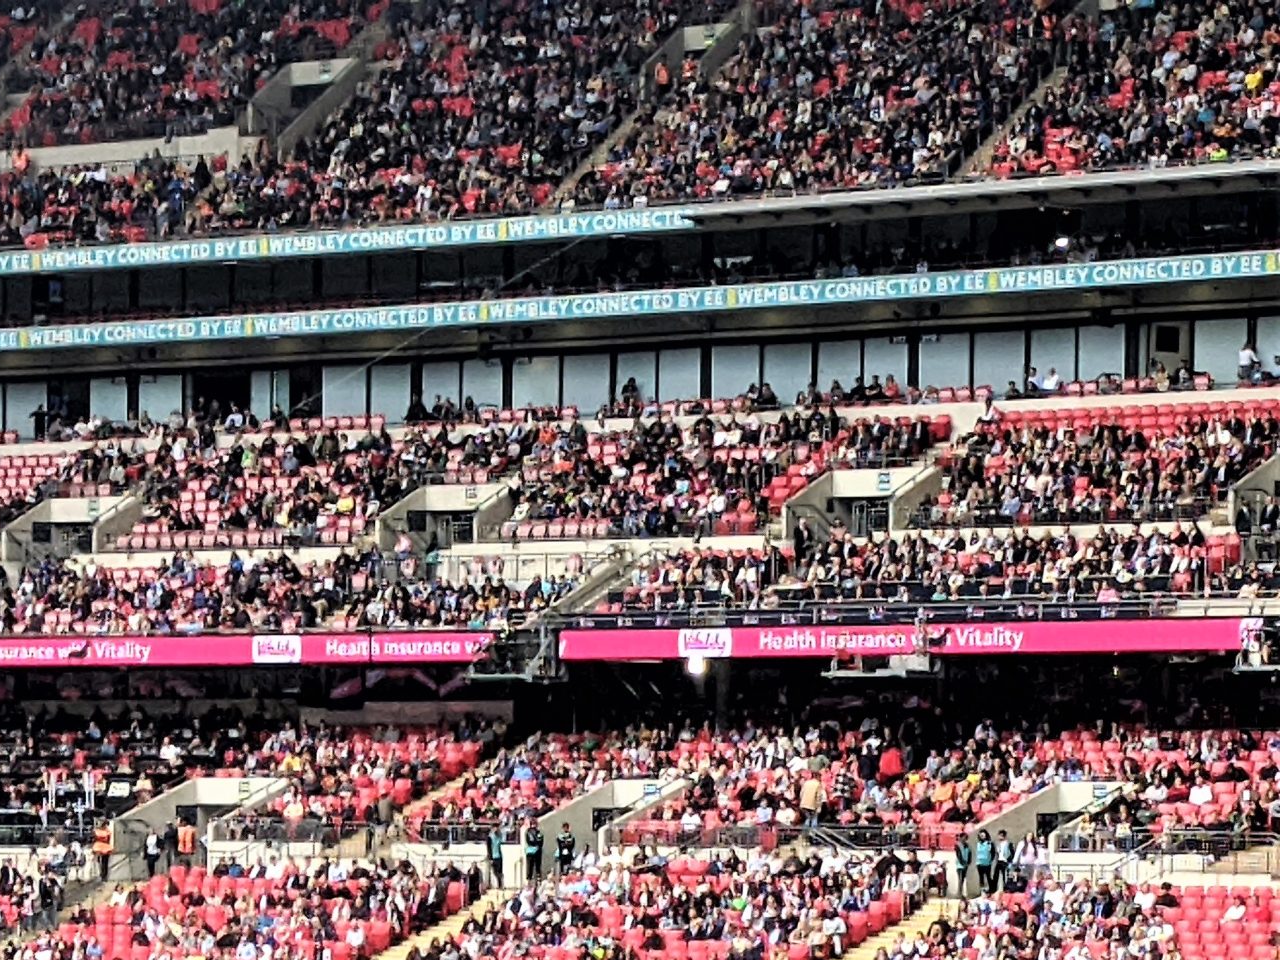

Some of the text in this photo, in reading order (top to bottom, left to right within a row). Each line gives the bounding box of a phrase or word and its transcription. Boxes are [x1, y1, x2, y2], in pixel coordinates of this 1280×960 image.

[508, 217, 590, 237] WEMBLEY
[269, 235, 346, 253] WEMBLEY
[350, 227, 446, 248] CONNECTED
[451, 225, 474, 241] BY
[42, 251, 115, 267] WEMBLEY
[118, 244, 210, 263] CONNECTED
[215, 243, 234, 256] BY
[1000, 267, 1088, 287] WEMBLEY
[1092, 259, 1204, 281] CONNECTED
[1211, 257, 1234, 273] BY
[738, 285, 822, 304] WEMBLEY
[825, 278, 929, 299] CONNECTED
[936, 276, 961, 291] BY
[489, 300, 569, 319] WEMBLEY
[573, 294, 672, 314] CONNECTED
[678, 292, 701, 308] BY
[255, 315, 330, 332] WEMBLEY
[332, 309, 428, 328] CONNECTED
[434, 307, 456, 322] BY
[31, 328, 100, 344] WEMBLEY
[104, 323, 194, 340] CONNECTED
[202, 321, 220, 335] BY
[326, 639, 380, 656] Health
[384, 640, 460, 655] insurance
[759, 631, 816, 649] Health
[820, 630, 906, 649] insurance
[956, 628, 1024, 650] Vitality
[94, 642, 152, 663] Vitality
